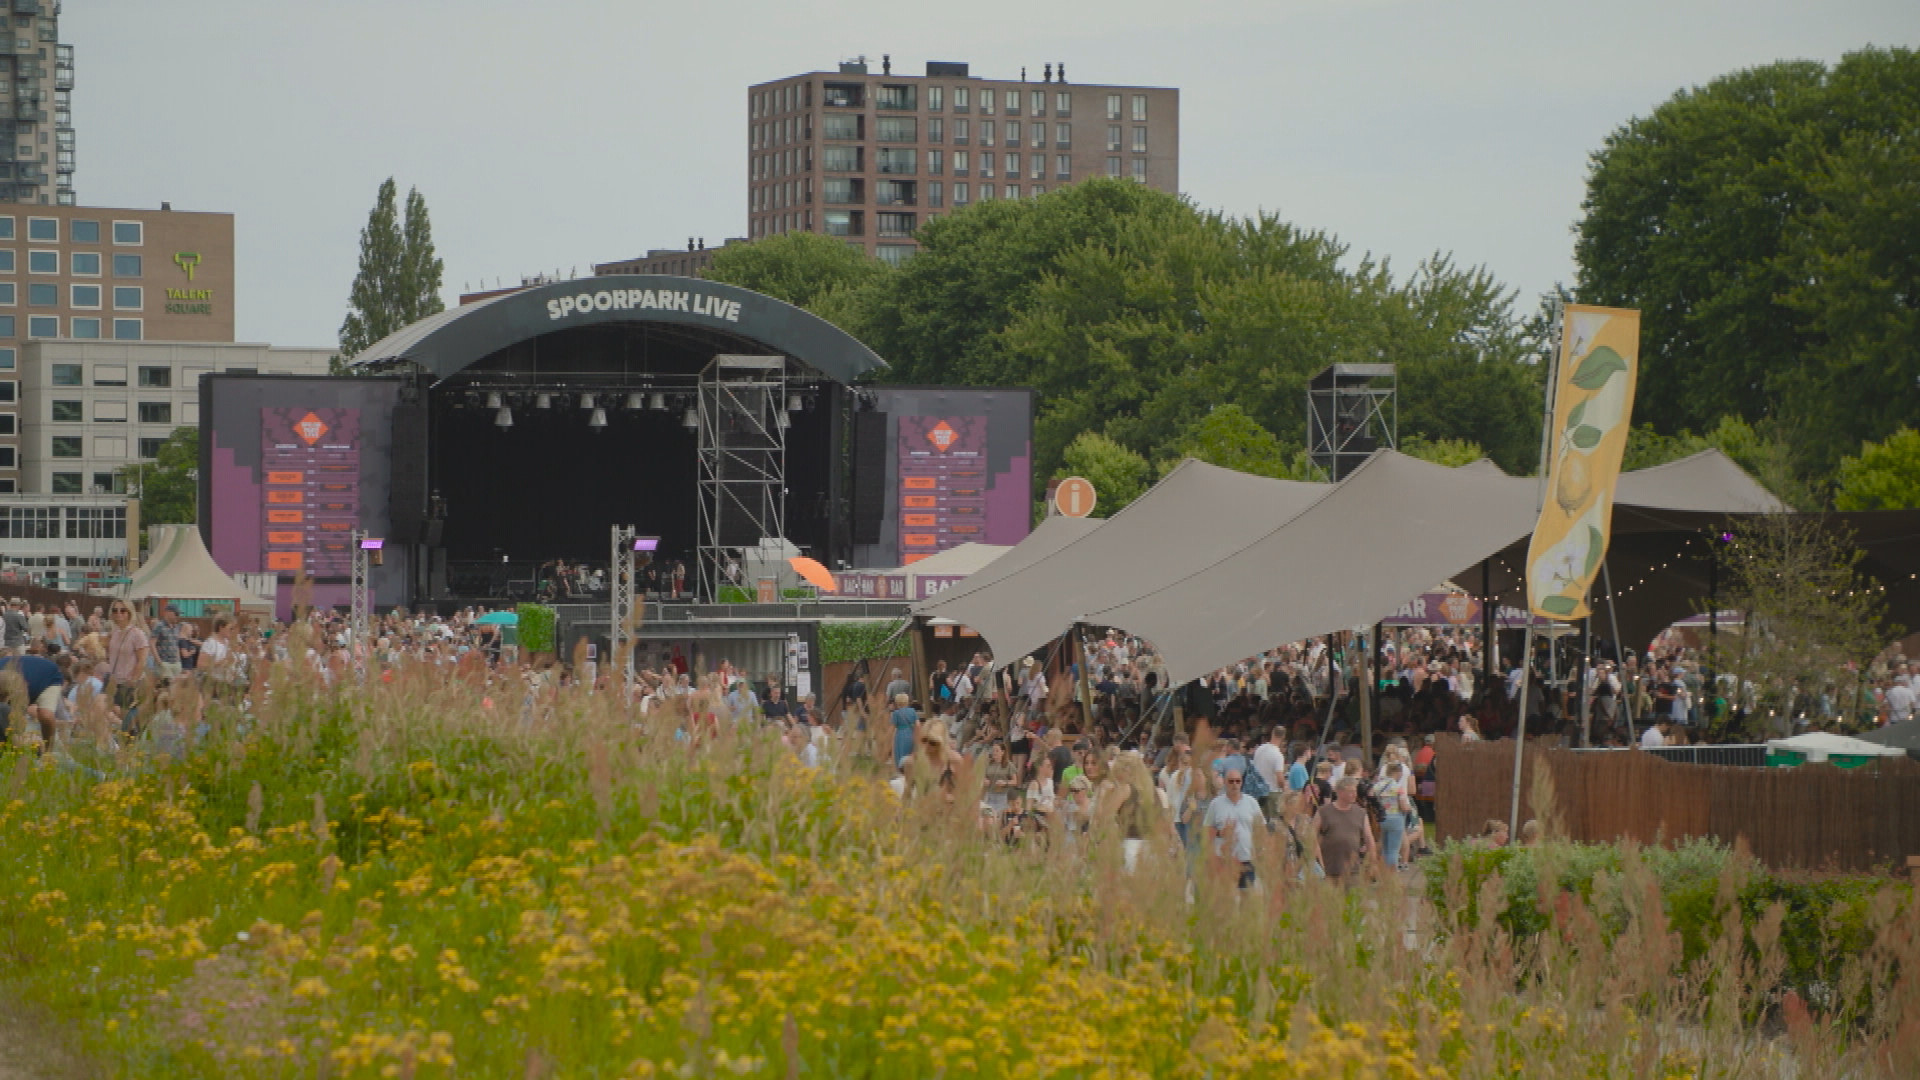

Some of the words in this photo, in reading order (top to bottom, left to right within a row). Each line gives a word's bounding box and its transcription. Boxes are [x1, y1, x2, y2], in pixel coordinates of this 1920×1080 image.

[166, 287, 213, 300] TALENT
[547, 289, 689, 321] SPOORPARK
[693, 293, 742, 323] LIVE
[925, 579, 960, 595] BA
[1387, 599, 1427, 618] AR
